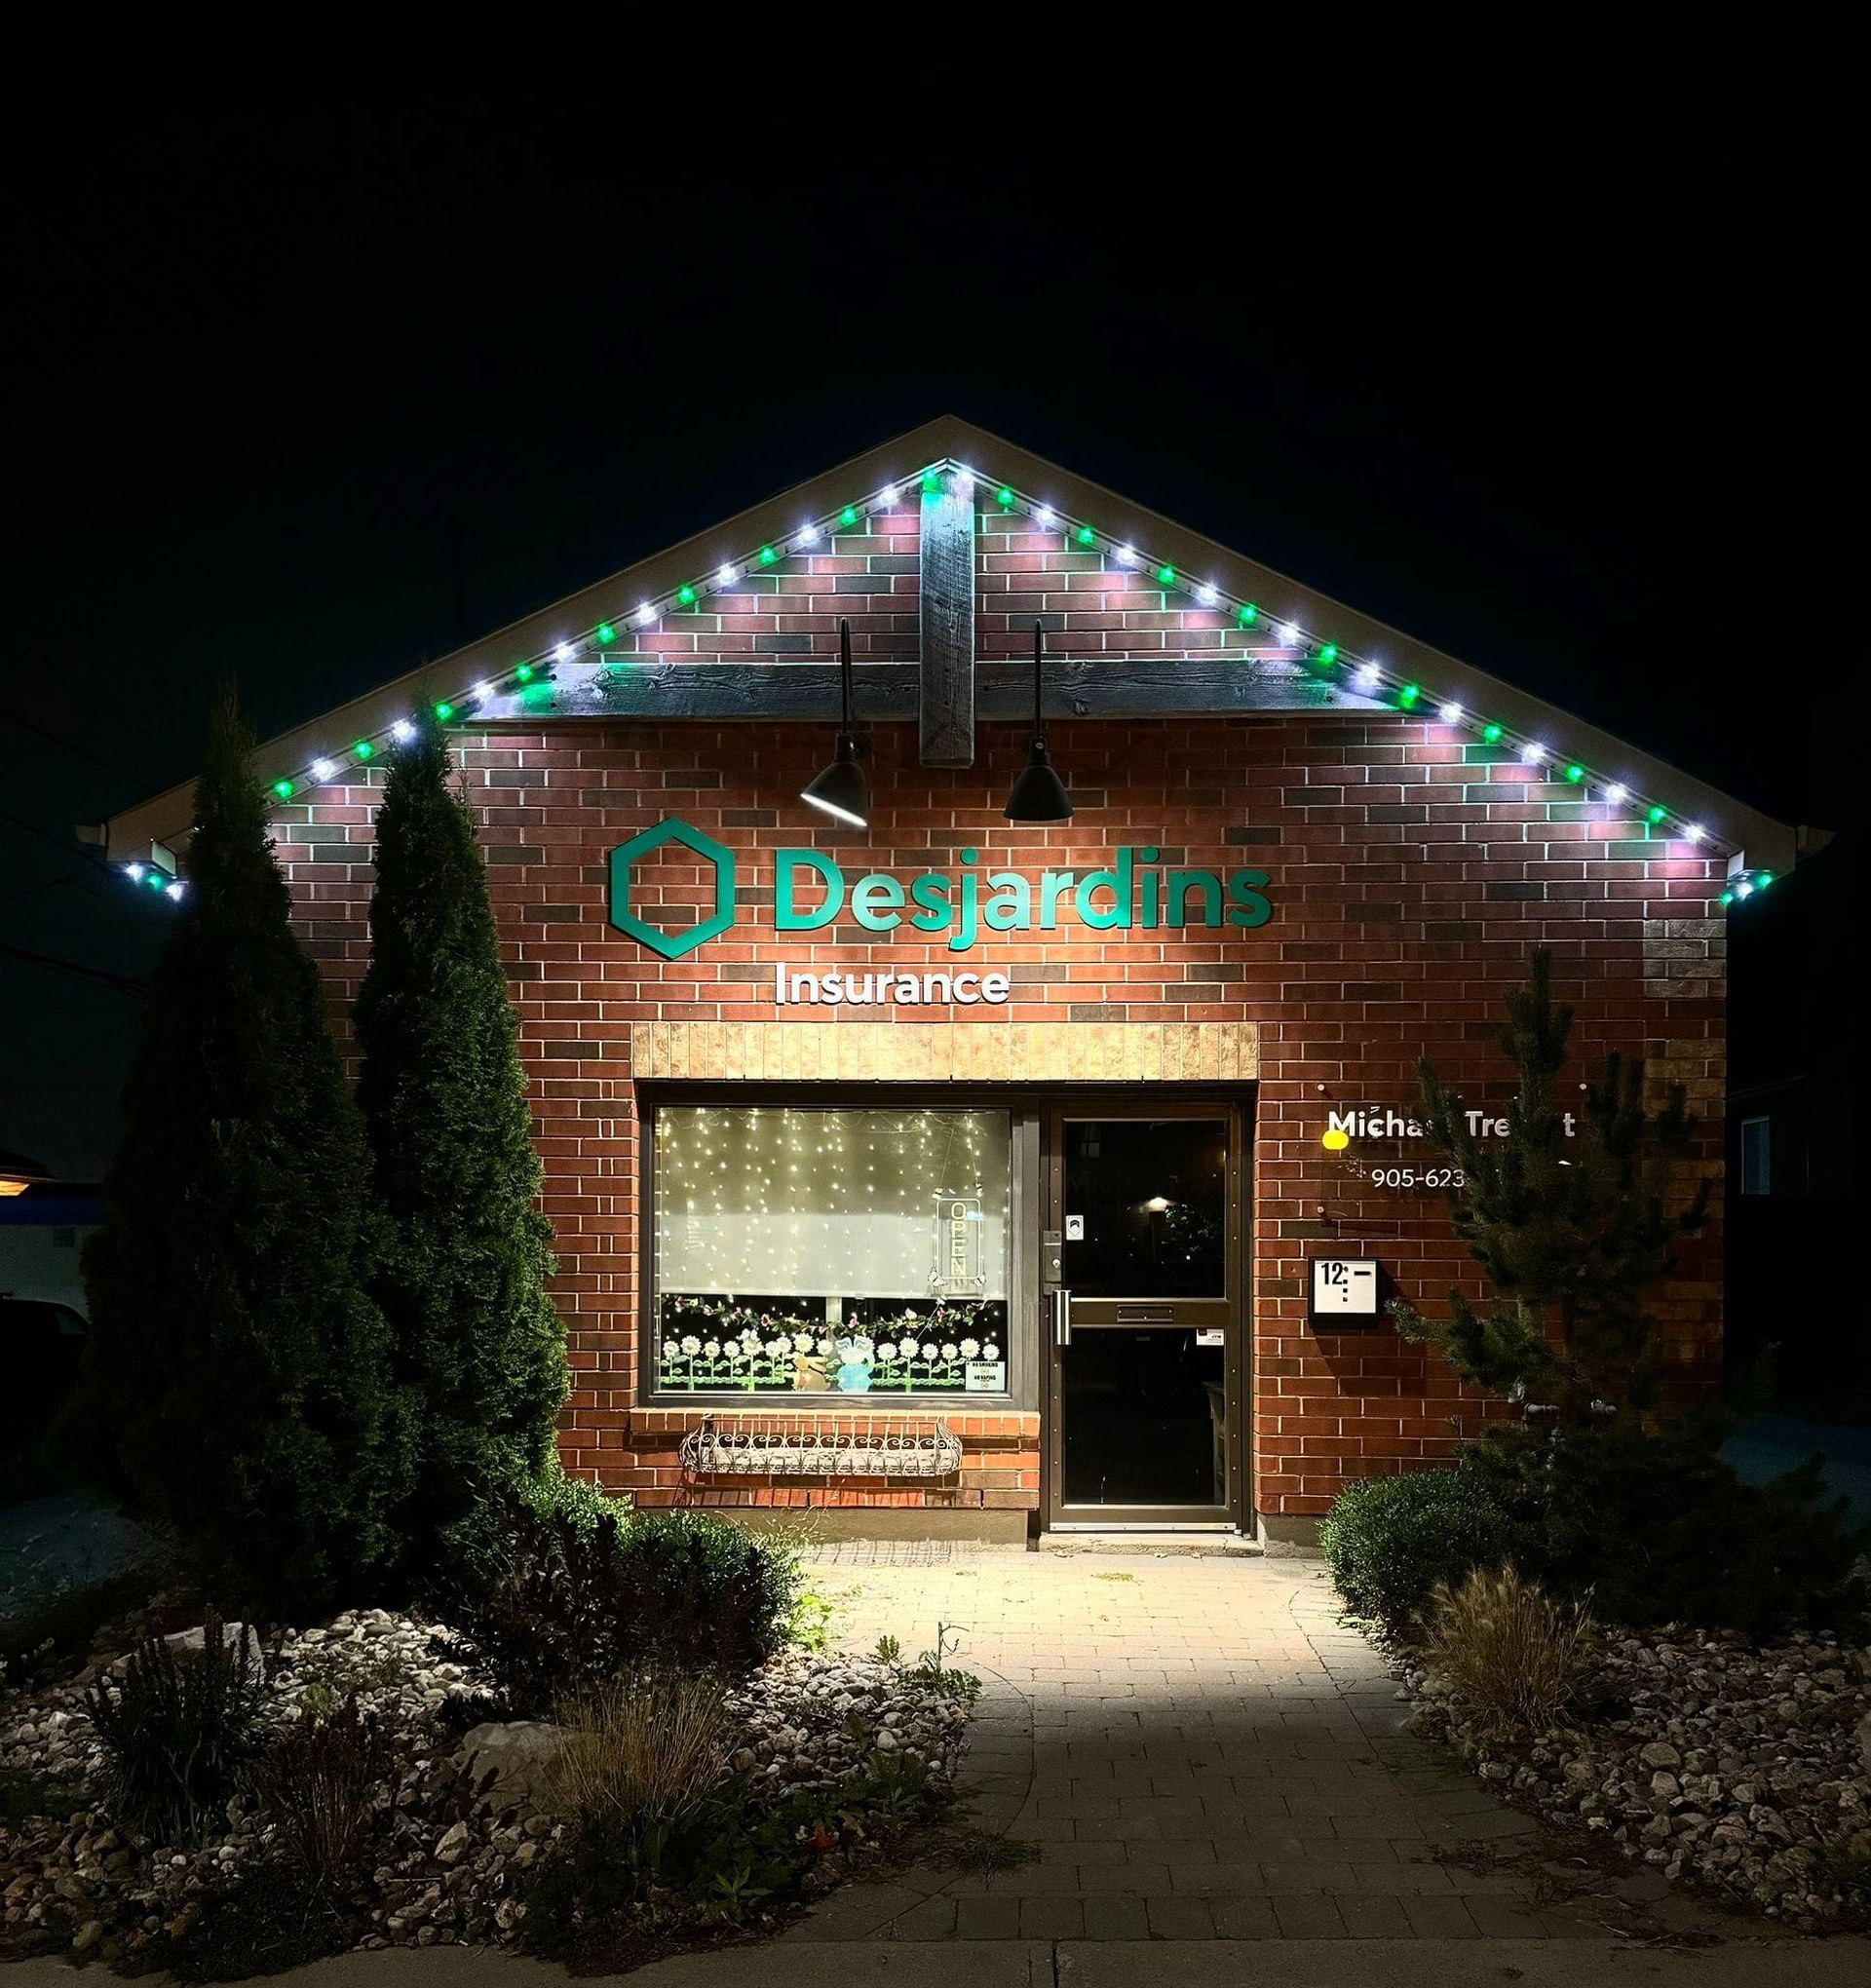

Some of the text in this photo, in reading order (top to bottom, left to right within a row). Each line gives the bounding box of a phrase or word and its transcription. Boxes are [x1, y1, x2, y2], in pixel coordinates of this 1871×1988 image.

[775, 847, 1273, 952] Desjardins
[775, 962, 1011, 1006] Insurance
[1328, 1110, 1433, 1137] Micha
[951, 1202, 967, 1276] OPEN
